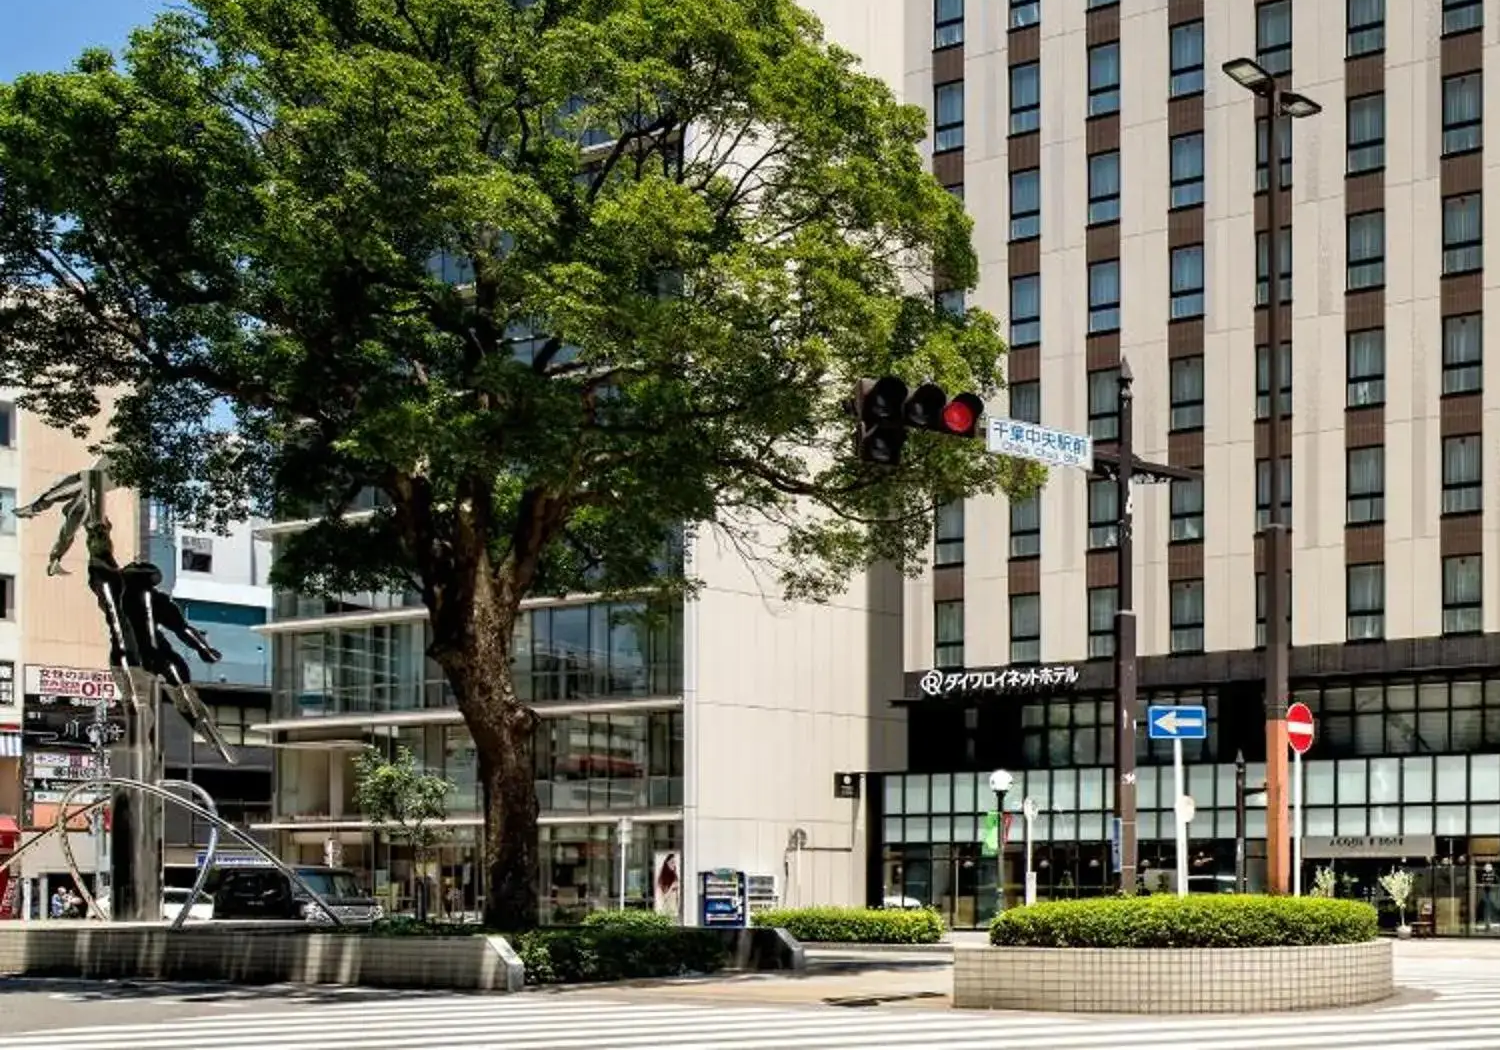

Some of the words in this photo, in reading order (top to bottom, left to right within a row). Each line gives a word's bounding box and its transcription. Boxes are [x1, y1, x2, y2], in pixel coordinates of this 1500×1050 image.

[994, 422, 1086, 456] 千葉中央駅前
[945, 666, 1079, 691] ダイワロイネットホテル
